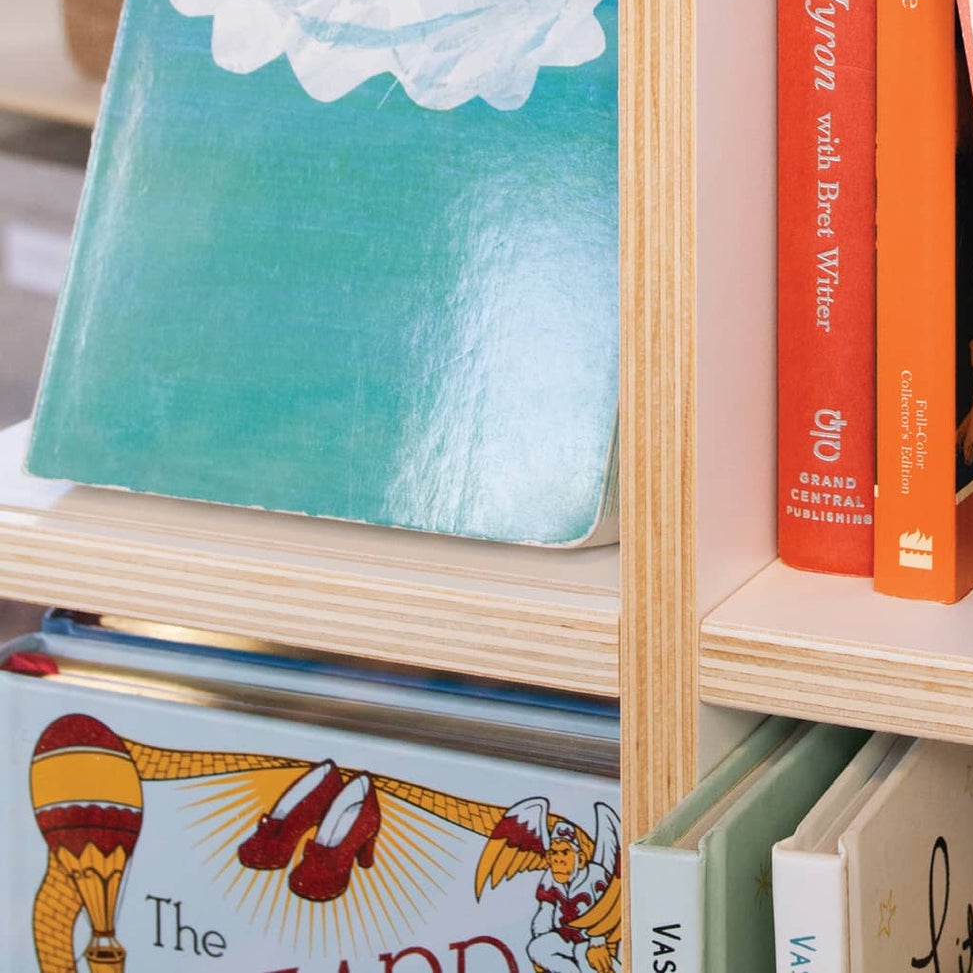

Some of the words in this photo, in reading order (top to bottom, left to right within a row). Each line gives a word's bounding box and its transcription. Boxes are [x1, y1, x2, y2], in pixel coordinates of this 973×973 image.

[816, 111, 841, 171] with
[816, 181, 840, 238] Bret
[816, 246, 839, 333] Witter
[900, 370, 913, 441] Collector's
[916, 399, 928, 470] Full-Color
[790, 488, 865, 508] CENTRAL
[799, 472, 857, 490] GRAND
[900, 445, 913, 495] Edition
[786, 505, 873, 525] PUBLISHING
[145, 895, 228, 958] The
